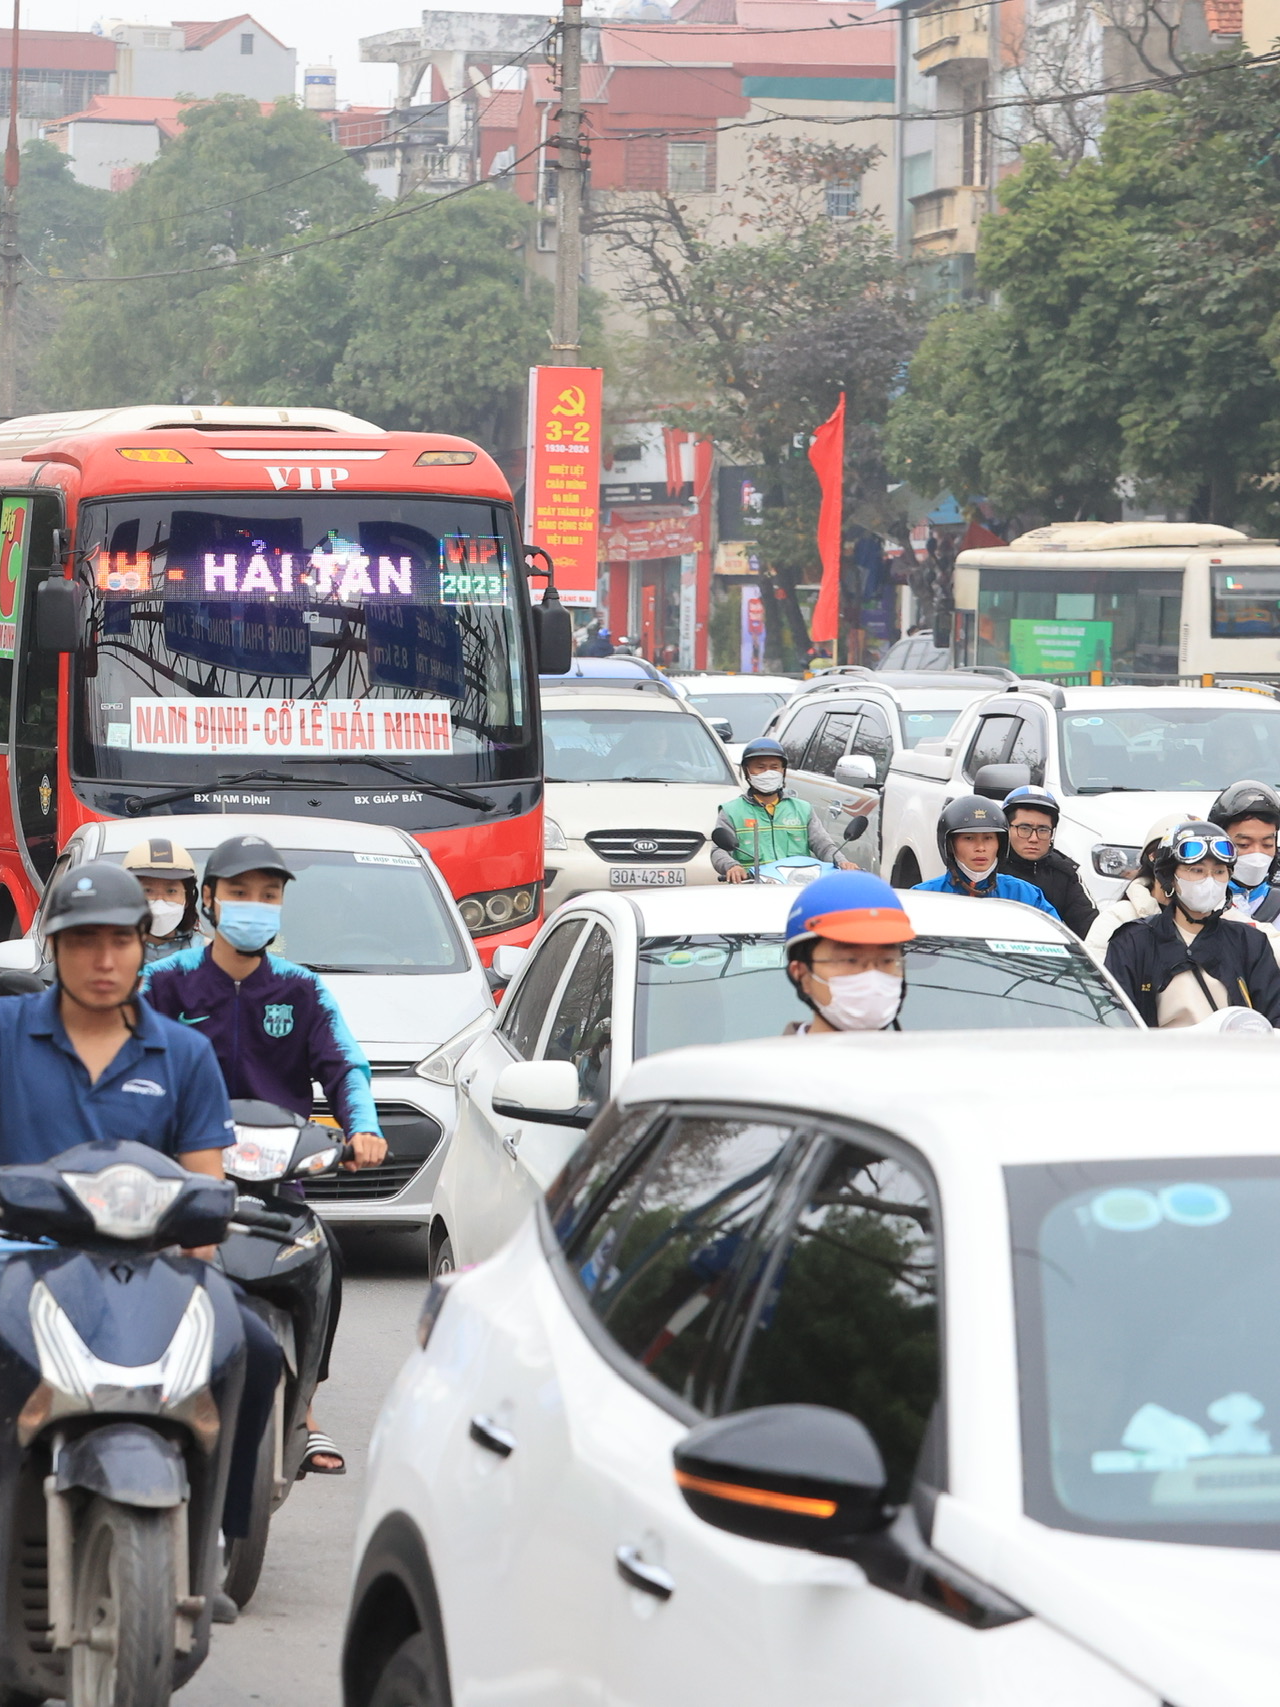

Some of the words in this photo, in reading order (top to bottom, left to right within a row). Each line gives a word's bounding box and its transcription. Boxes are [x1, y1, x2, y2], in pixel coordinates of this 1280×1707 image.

[545, 420, 590, 442] 3-2
[544, 444, 590, 453] 1930-2024
[264, 466, 350, 491] VIP
[3, 505, 17, 542] Big
[204, 539, 294, 593] HẢI
[444, 576, 500, 594] 2023
[135, 705, 189, 745] NAM
[195, 706, 248, 751] ĐỊNH
[264, 699, 296, 746] CỔ
[300, 700, 328, 747] LỄ
[331, 699, 376, 750] HẢI
[384, 711, 451, 751] NINH
[194, 793, 210, 803] BX
[213, 794, 238, 804] NAM
[242, 794, 271, 806] ĐỊNH
[354, 795, 370, 805] BX
[372, 793, 400, 805] GIÁP
[636, 842, 654, 850] KIA
[612, 869, 684, 885] 30A-425.84
